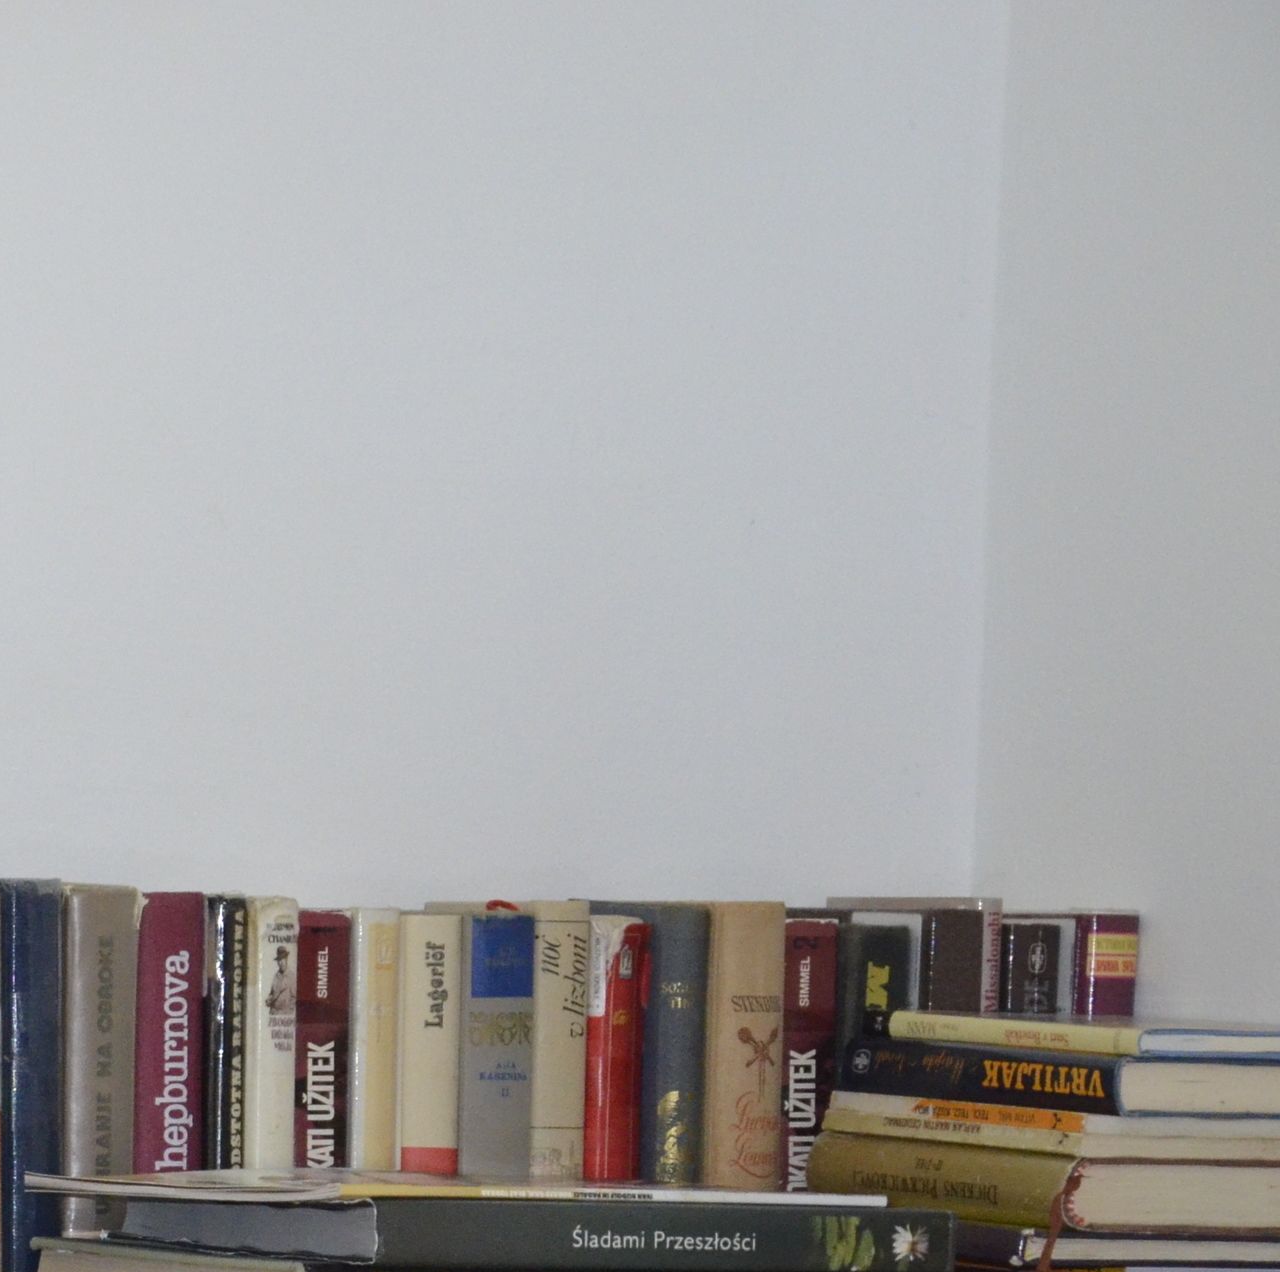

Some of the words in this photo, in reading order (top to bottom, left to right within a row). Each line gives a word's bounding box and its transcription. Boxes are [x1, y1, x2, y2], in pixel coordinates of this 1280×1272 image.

[317, 946, 329, 998] SIMMEL
[425, 942, 446, 1028] Lagerlöf
[562, 933, 587, 1016] lizboni
[799, 956, 810, 1007] SIMMEL
[983, 911, 1001, 1013] Missalonghi
[155, 950, 189, 1170] hepburnova
[302, 1041, 335, 1121] UŽITEK
[784, 1049, 816, 1128] UŽITEK
[982, 1060, 1105, 1098] VRTILJAK
[572, 1224, 651, 1249] Śladami
[653, 1228, 757, 1252] Przeszłości
